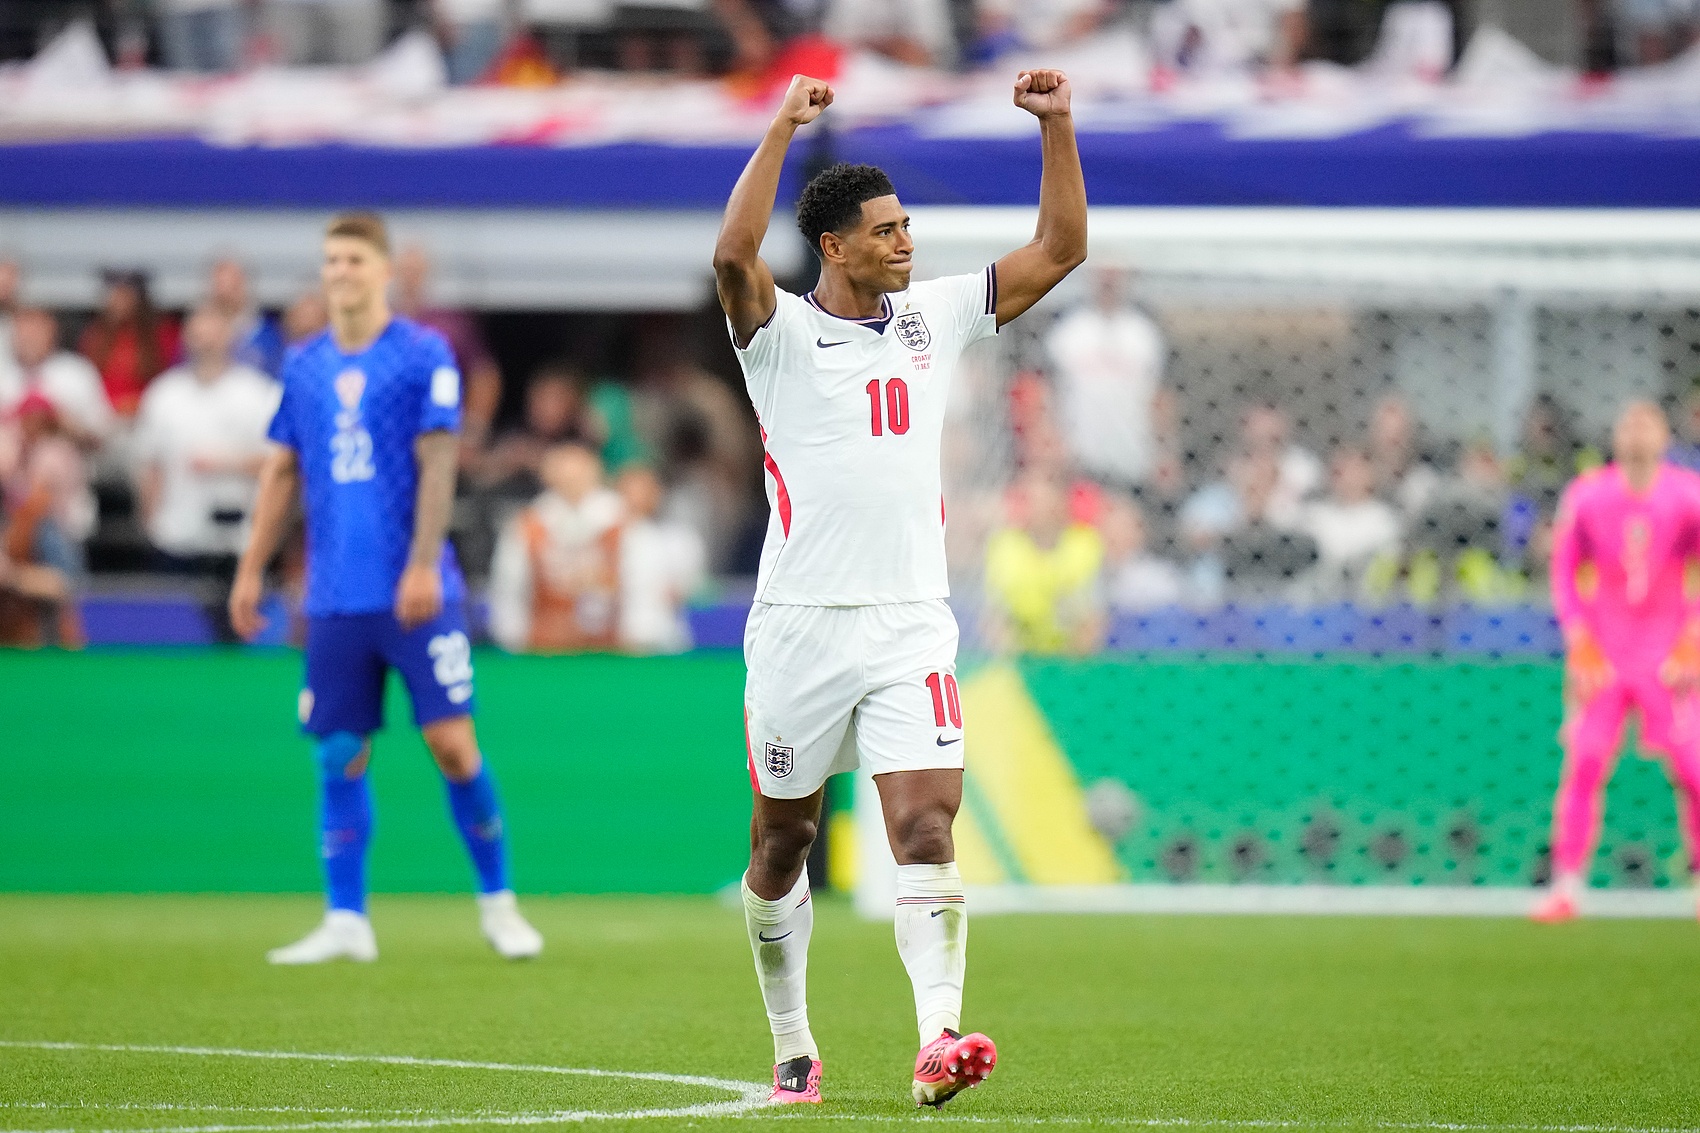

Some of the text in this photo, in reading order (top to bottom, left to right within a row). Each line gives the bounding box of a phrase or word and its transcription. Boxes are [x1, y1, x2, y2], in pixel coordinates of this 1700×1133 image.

[865, 377, 911, 437] 10
[330, 431, 376, 483] 22
[925, 672, 962, 730] 10
